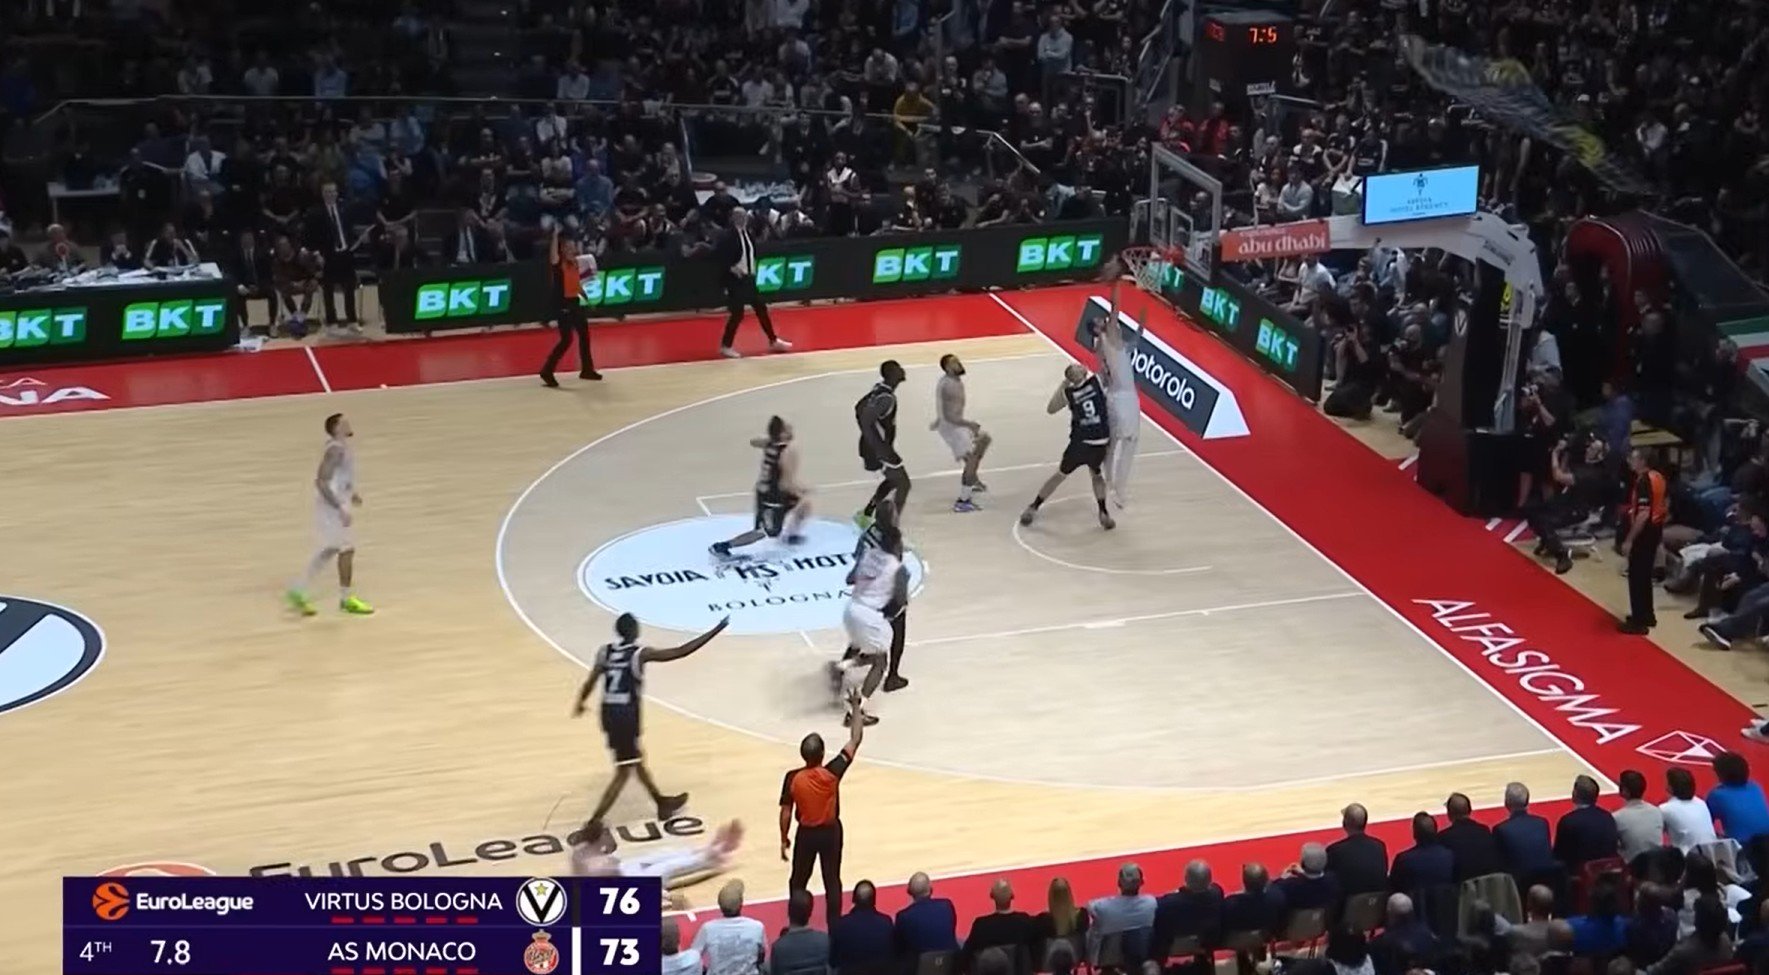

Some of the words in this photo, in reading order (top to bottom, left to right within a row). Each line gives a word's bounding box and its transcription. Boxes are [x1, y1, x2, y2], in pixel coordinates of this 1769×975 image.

[1019, 240, 1099, 267] BKT
[1238, 237, 1273, 254] abu
[1274, 232, 1325, 252] dhabi
[756, 261, 812, 286] KT
[875, 250, 957, 276] BKT
[418, 285, 508, 313] BKT
[1201, 286, 1239, 326] BKT
[126, 304, 223, 333] BKT
[1257, 321, 1298, 365] BKT
[1082, 400, 1096, 418] 9
[604, 569, 709, 591] SAVOIA
[1412, 598, 1642, 744] ALFASIGMA
